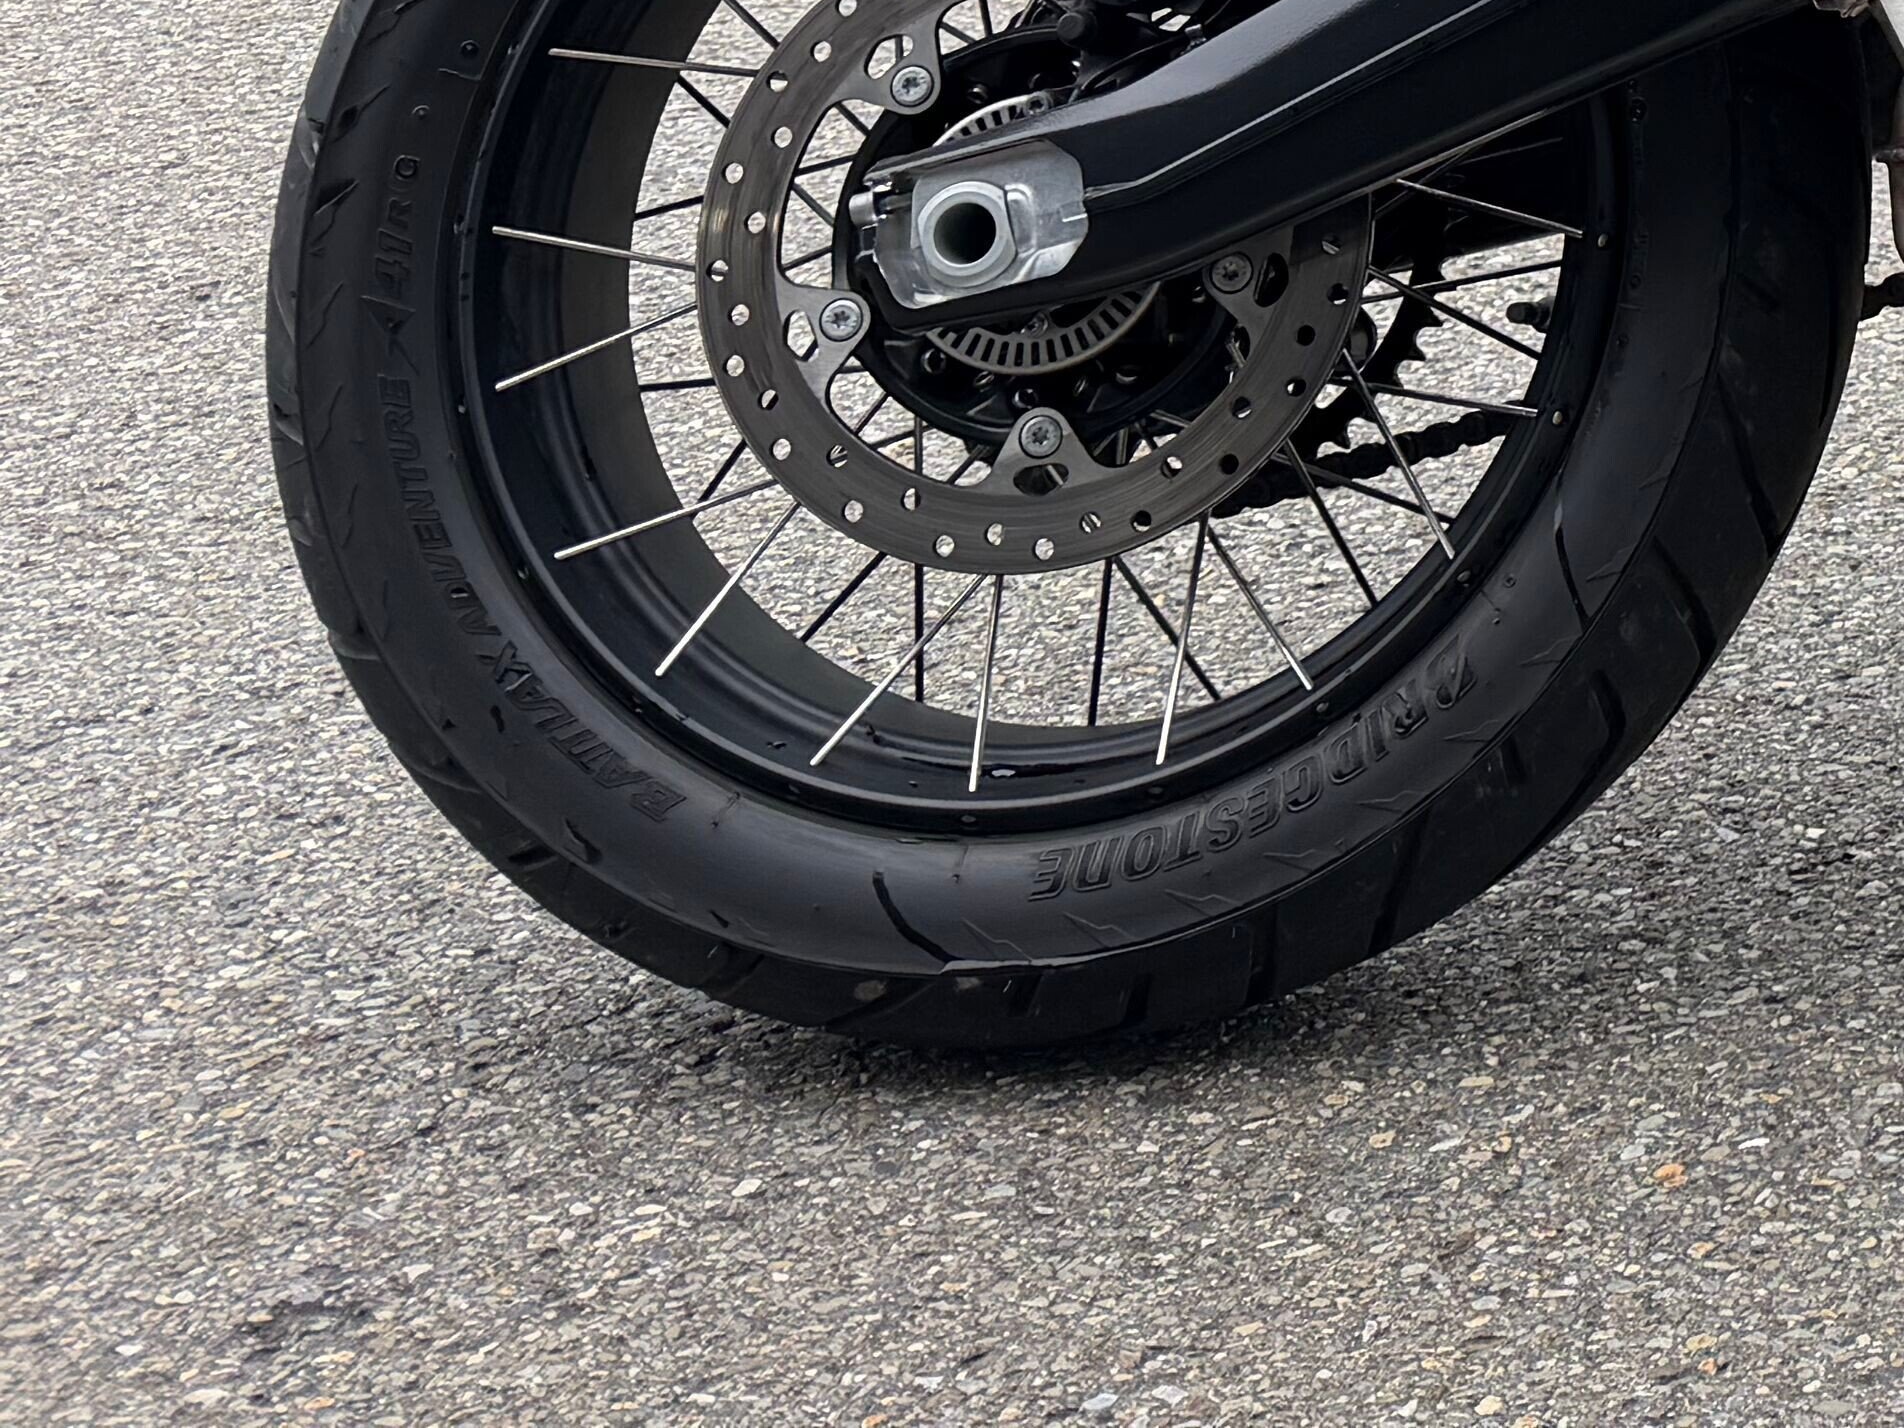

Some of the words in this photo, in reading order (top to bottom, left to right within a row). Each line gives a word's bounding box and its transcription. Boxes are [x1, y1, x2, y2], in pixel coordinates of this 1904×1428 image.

[377, 372, 502, 638] ADVENTURE
[476, 641, 688, 824] BATTLAX
[1027, 634, 1476, 902] BRIDGESTONE
